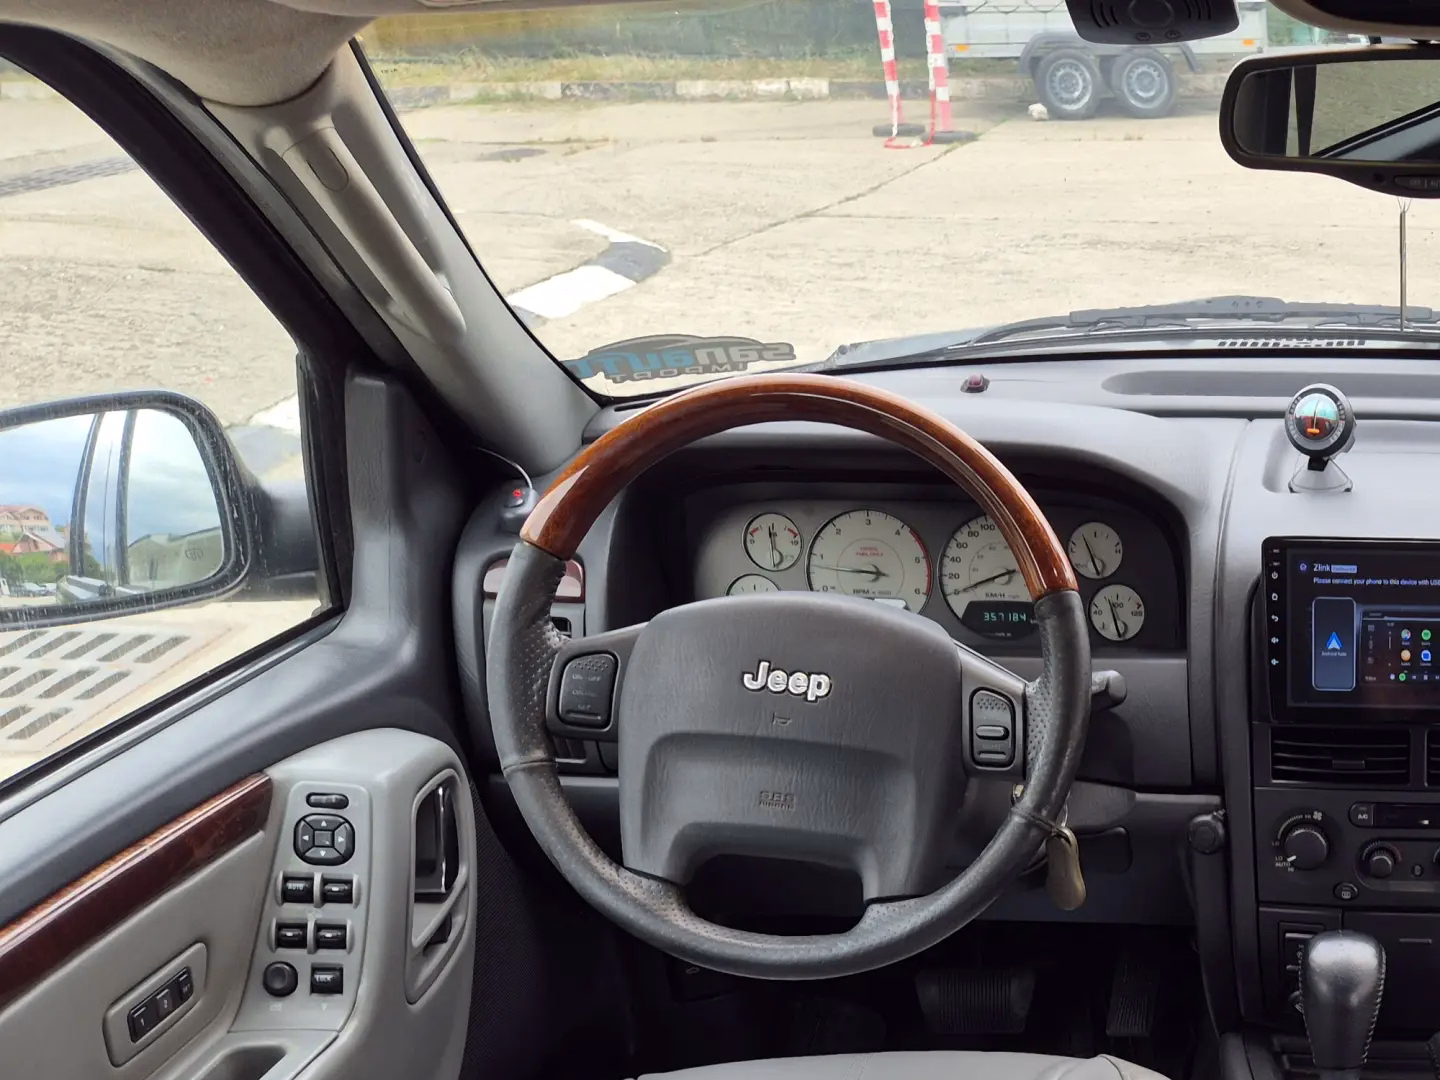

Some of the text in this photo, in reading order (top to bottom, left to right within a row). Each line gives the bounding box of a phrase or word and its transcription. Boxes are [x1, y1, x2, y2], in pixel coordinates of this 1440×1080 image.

[980, 523, 996, 531] 100
[967, 530, 979, 538] 80
[956, 541, 968, 549] 60
[1366, 578, 1382, 586] phone
[743, 661, 831, 702] Jeep
